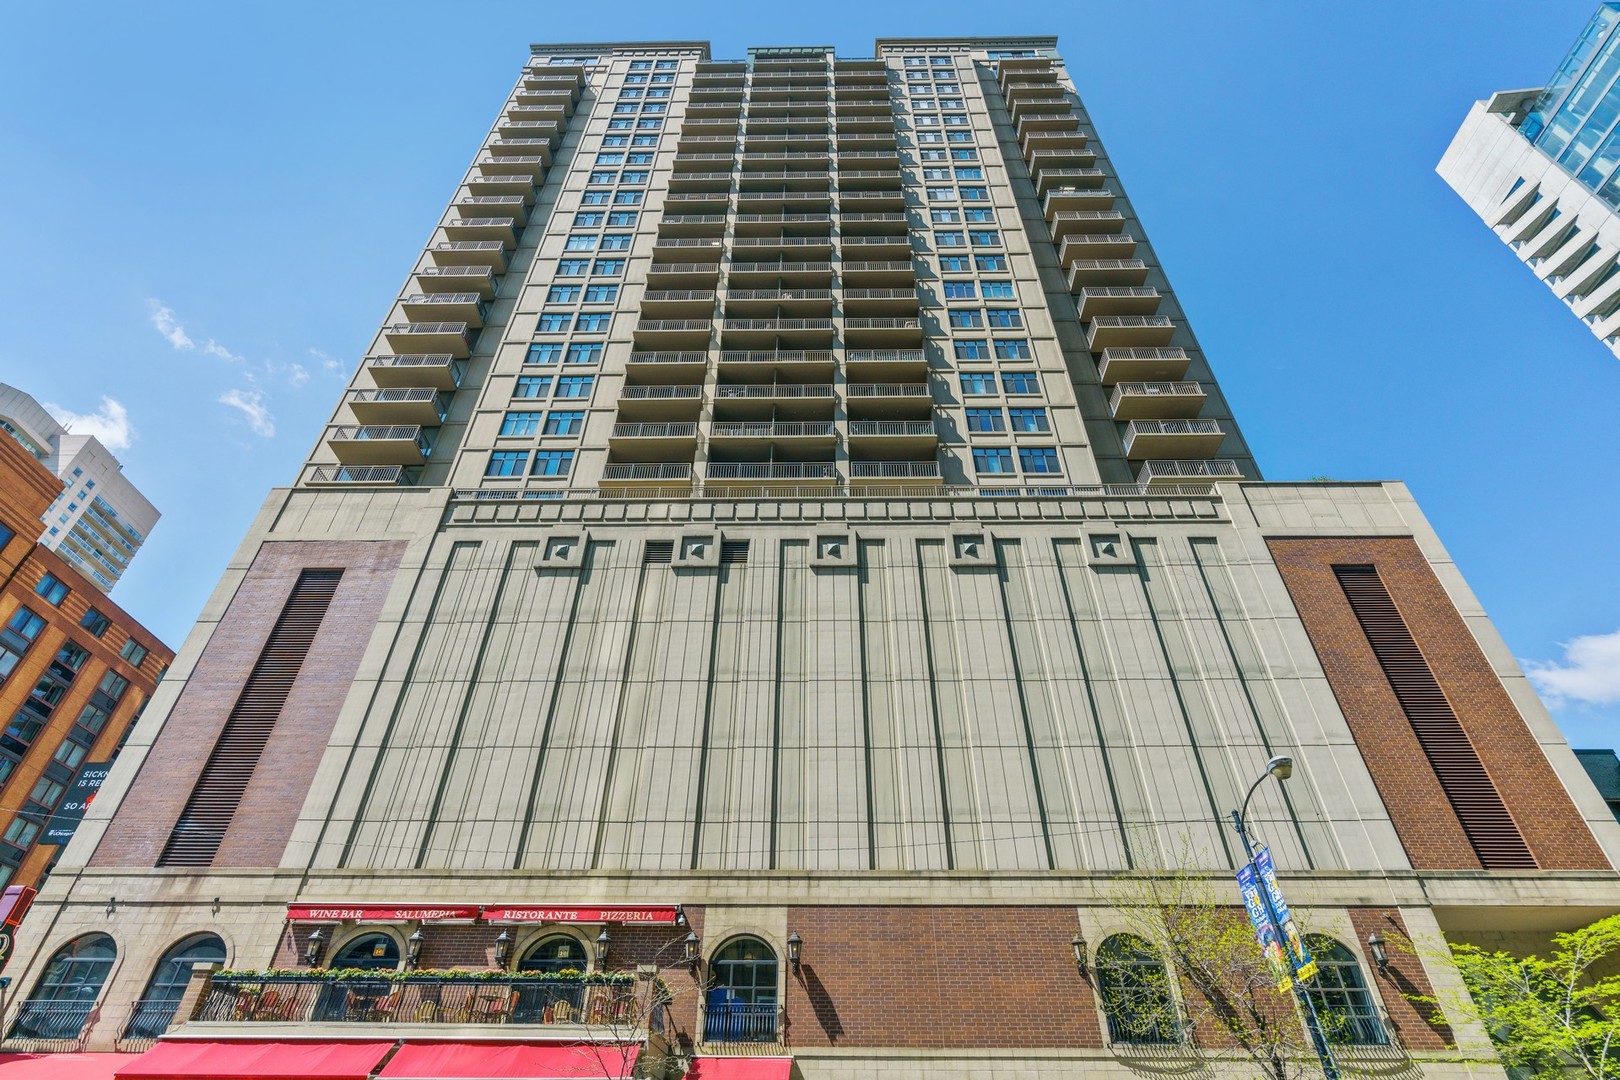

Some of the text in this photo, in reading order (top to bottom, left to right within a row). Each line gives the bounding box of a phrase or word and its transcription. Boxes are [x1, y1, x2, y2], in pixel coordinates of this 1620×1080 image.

[77, 779, 87, 787] IS
[64, 802, 78, 810] SO
[309, 909, 456, 919] WINE BAR SALUMERIA
[503, 911, 654, 920] RISTORANTE PIZZERIA
